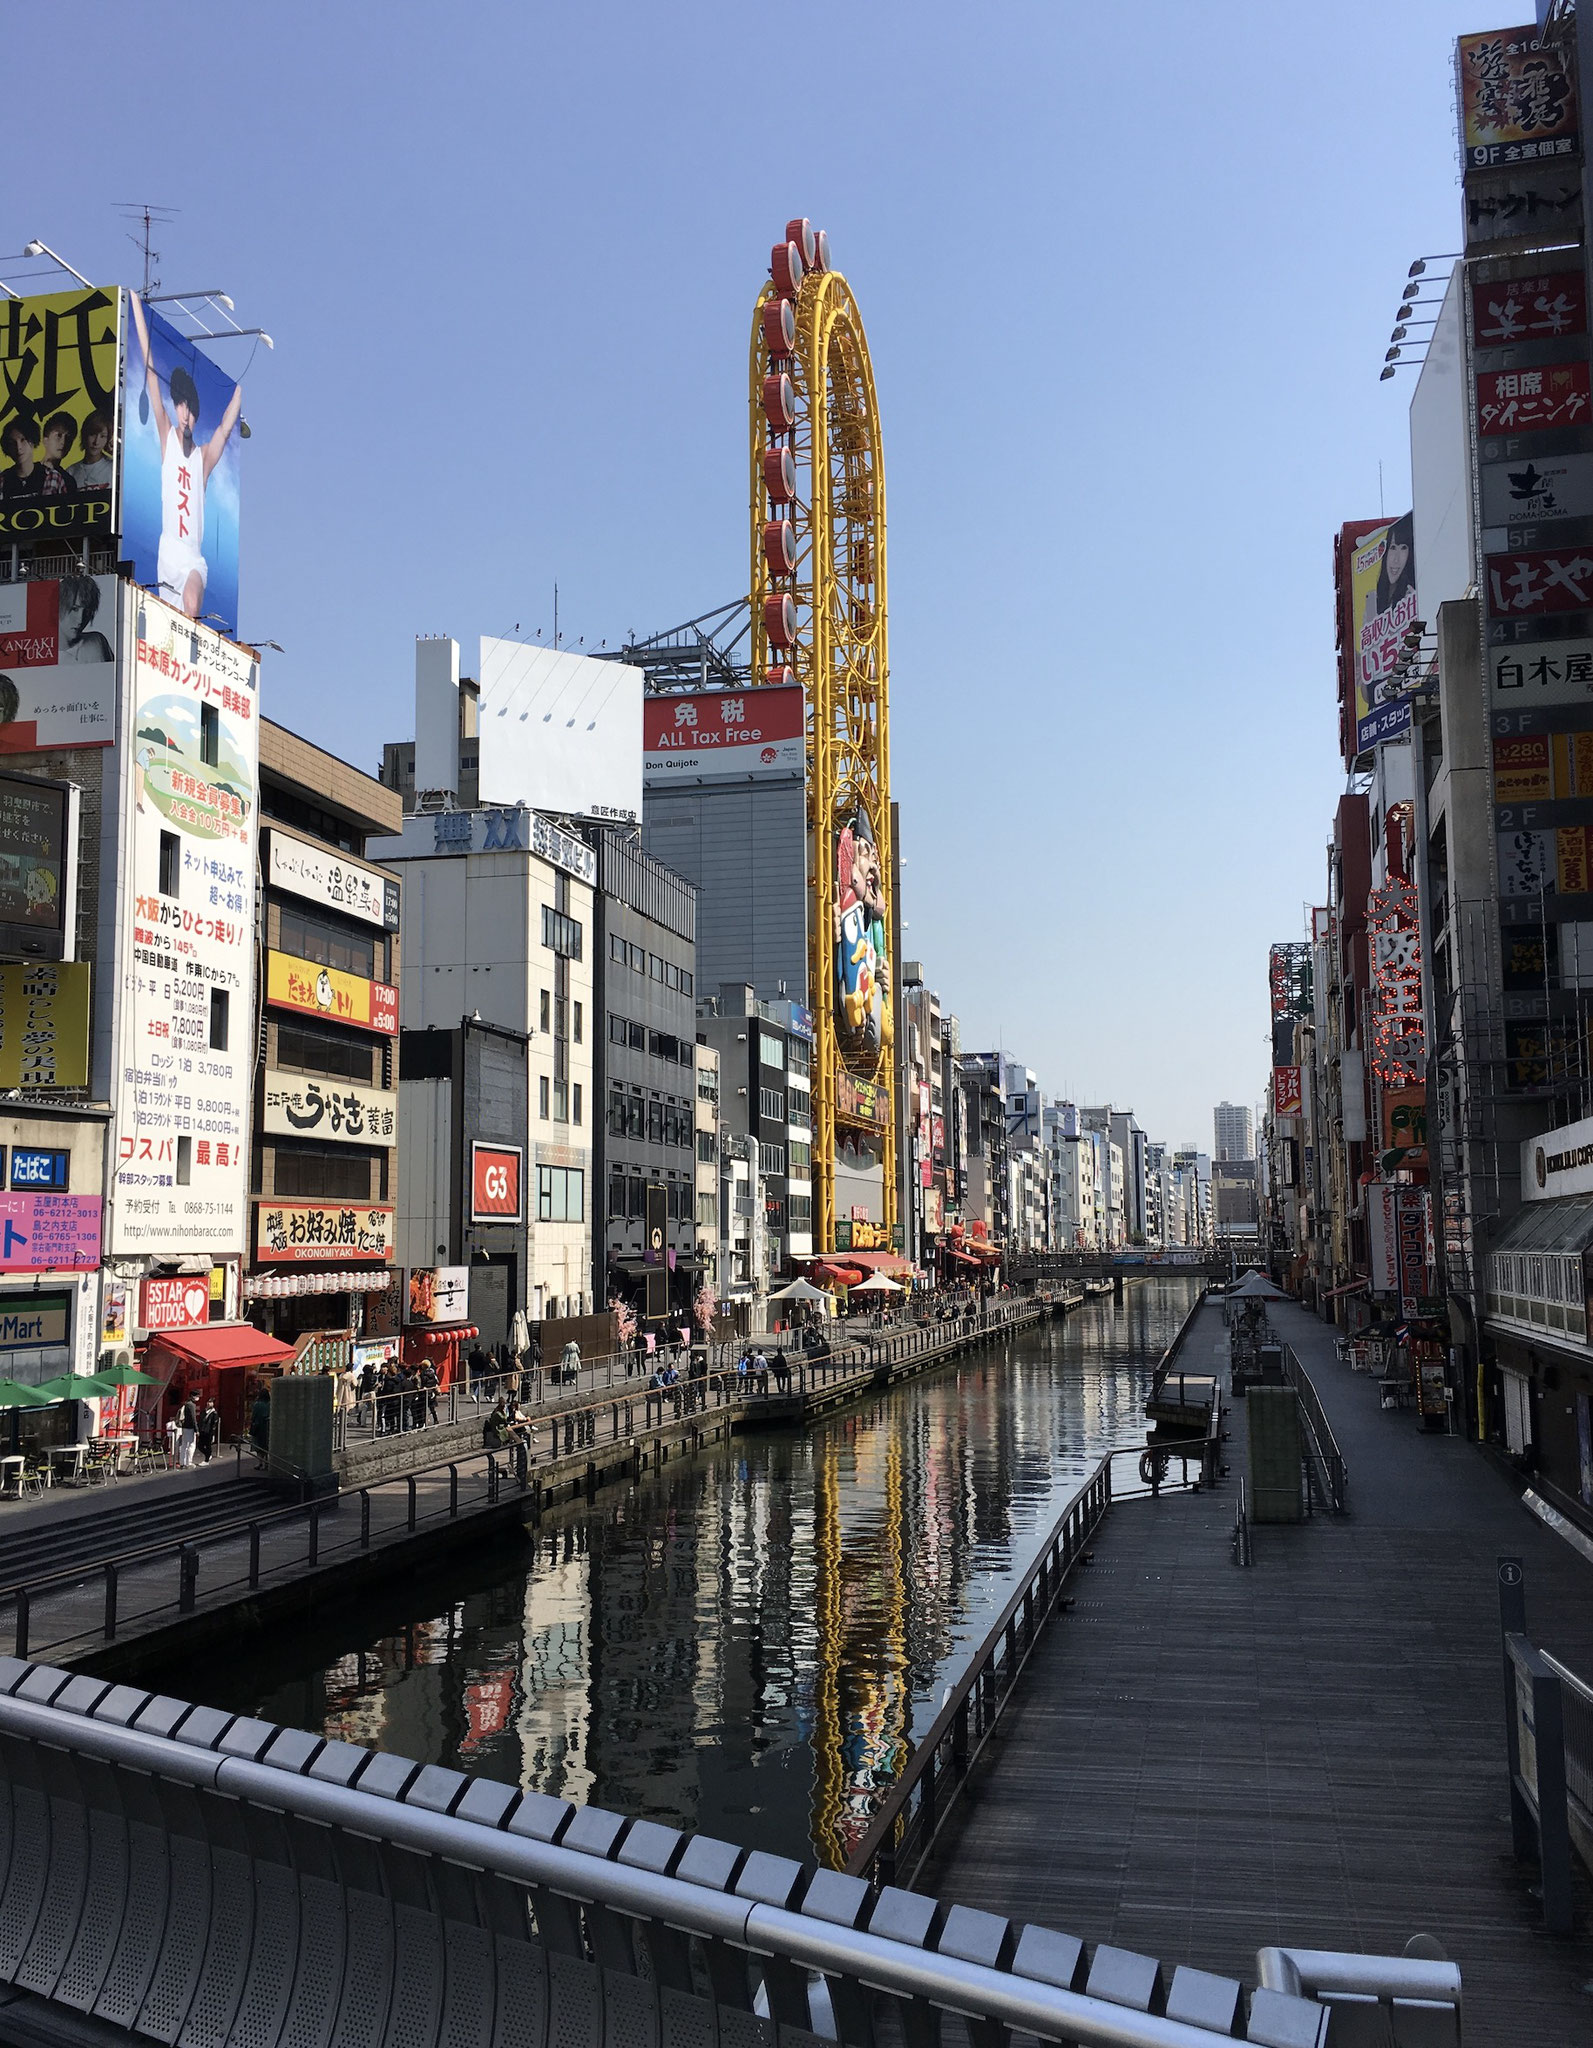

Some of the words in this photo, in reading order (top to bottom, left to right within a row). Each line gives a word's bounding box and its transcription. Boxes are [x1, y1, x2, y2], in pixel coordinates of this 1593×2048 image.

[1474, 146, 1500, 165] 9F
[1505, 139, 1573, 162] 全室個室
[1496, 371, 1543, 399] 相席
[1481, 392, 1589, 431] ダイニング
[177, 465, 191, 538] ホスト
[1493, 622, 1529, 641] 4F
[136, 638, 251, 720] 日本原カンツリー倶楽部
[1496, 653, 1593, 689] 白木屋
[674, 698, 745, 728] 免税
[657, 732, 685, 747] ALL
[691, 730, 720, 744] Tax
[726, 727, 762, 742] Free
[666, 760, 699, 769] Quijote
[135, 894, 244, 947] 大阪からひとつ走り！
[288, 972, 316, 1006] だまれ
[336, 989, 353, 1019] トリ
[374, 985, 395, 1006] 17:00
[198, 1061, 233, 1079] 3,780円
[1287, 1068, 1299, 1098] ツルハ
[120, 1136, 174, 1162] コスパ
[196, 1140, 240, 1167] 最高！
[14, 1156, 51, 1181] たばこ
[485, 1165, 508, 1200] G3
[33, 1209, 98, 1218] 06-6212-3013
[125, 1199, 160, 1214] 予約受付
[184, 1201, 234, 1215] 0868-75-1144
[32, 1220, 78, 1232] 島之内支店
[289, 1209, 357, 1245] お好み焼
[295, 1247, 354, 1259] OKONOMIYAKI
[1403, 1212, 1425, 1268] ダイコク
[149, 1281, 183, 1305] 5STAR
[148, 1302, 186, 1324] HOTDOG
